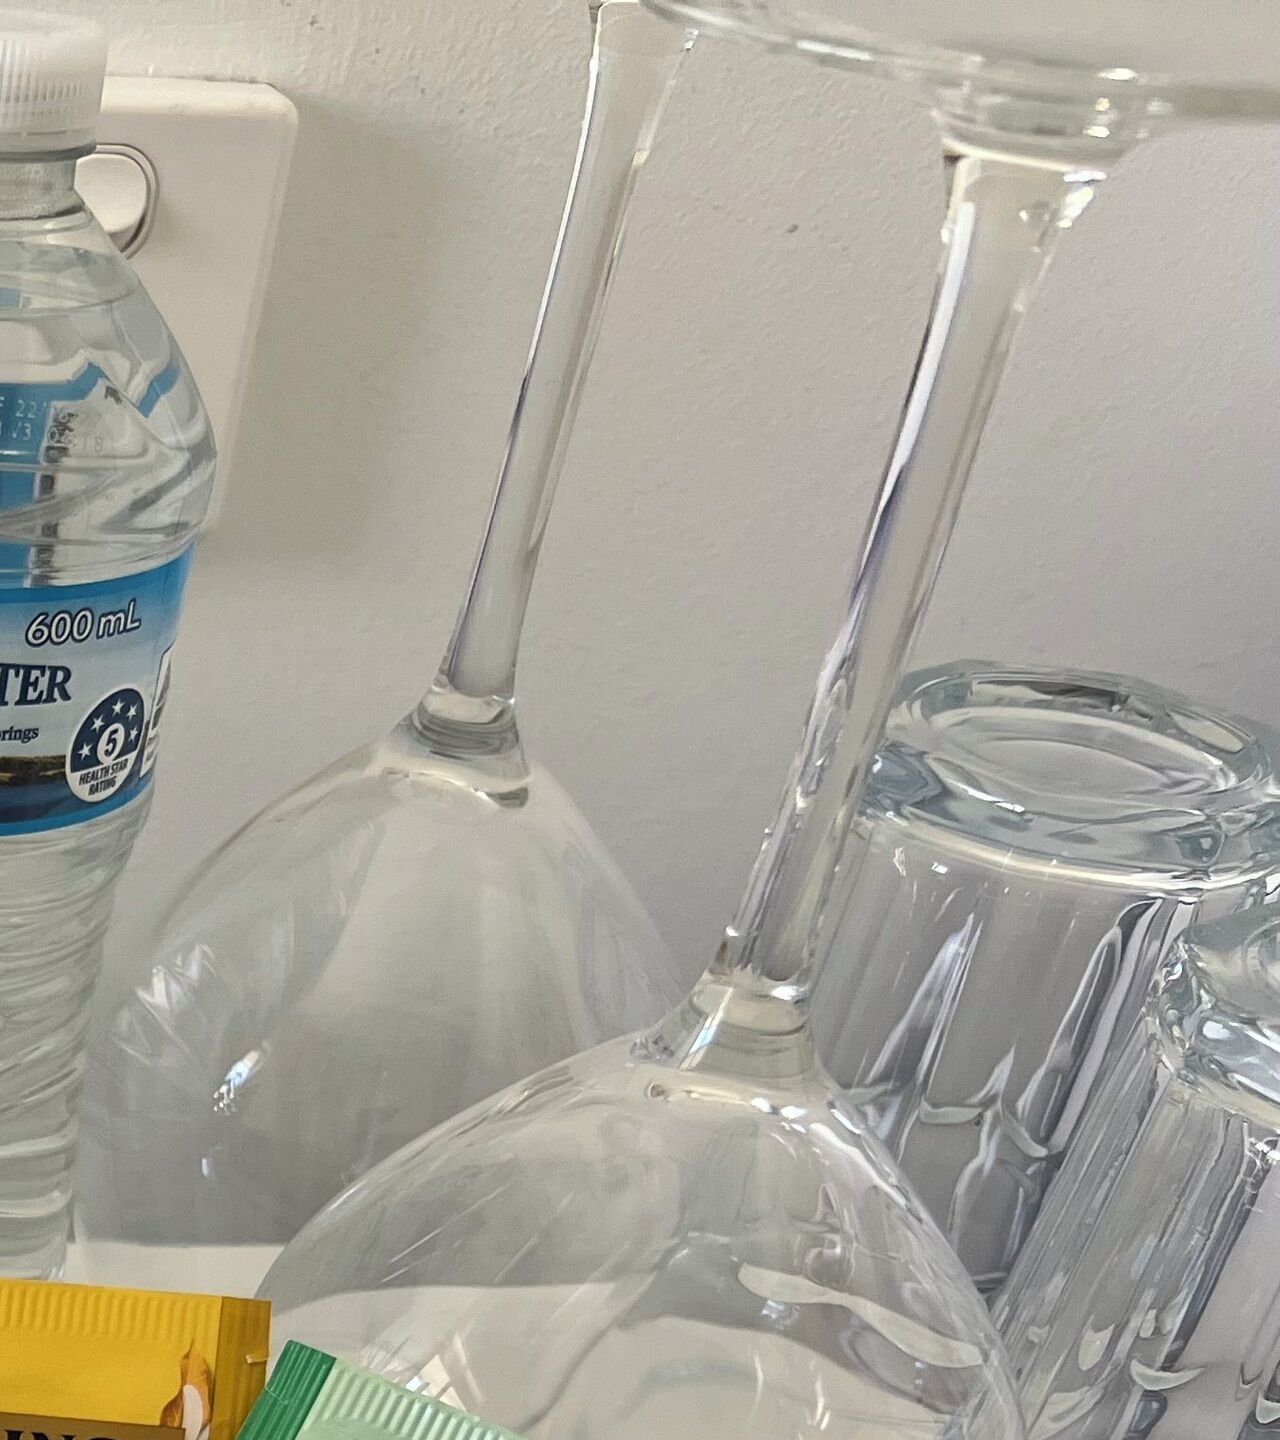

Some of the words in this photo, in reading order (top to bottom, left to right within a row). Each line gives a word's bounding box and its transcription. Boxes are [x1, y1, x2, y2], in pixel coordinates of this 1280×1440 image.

[25, 613, 92, 647] 600
[98, 600, 141, 636] mL
[105, 728, 119, 757] 5
[79, 765, 110, 786] HEALTH
[110, 758, 128, 775] STAR
[88, 776, 117, 796] RATING
